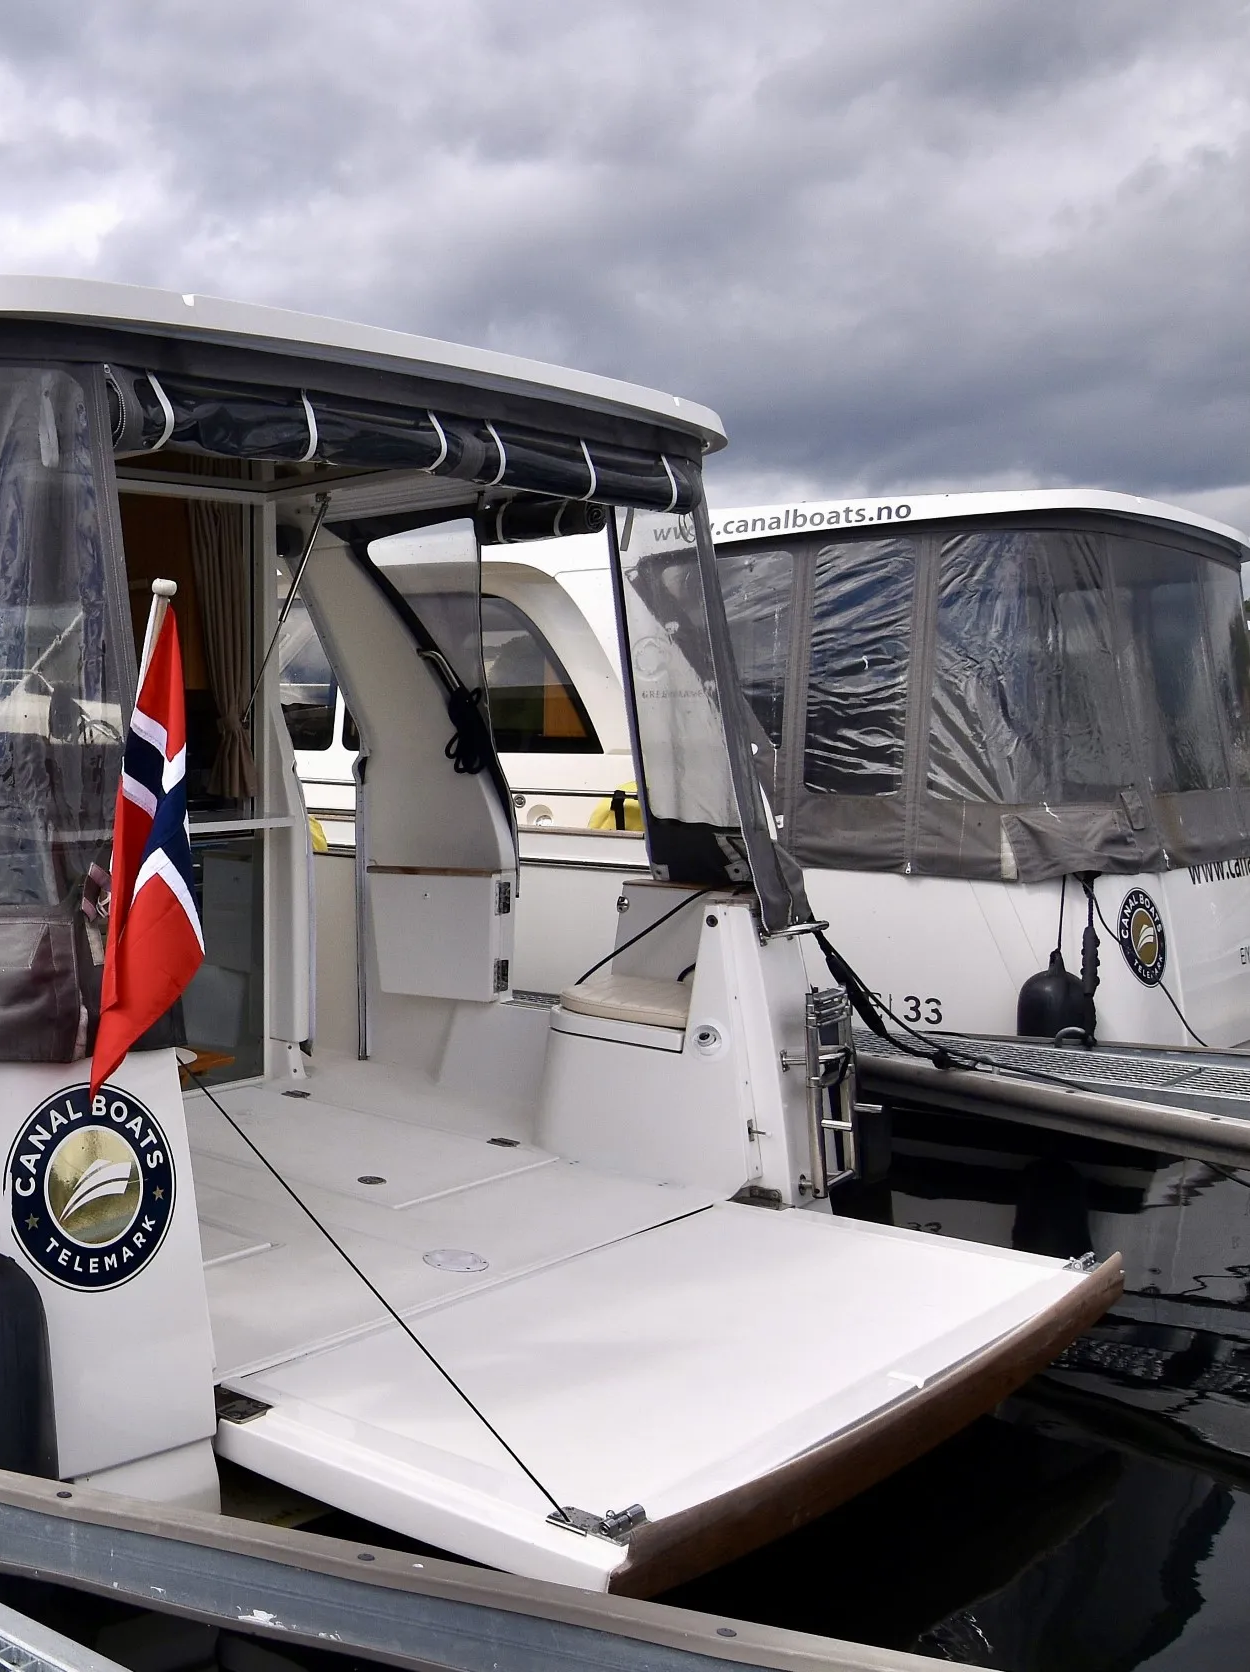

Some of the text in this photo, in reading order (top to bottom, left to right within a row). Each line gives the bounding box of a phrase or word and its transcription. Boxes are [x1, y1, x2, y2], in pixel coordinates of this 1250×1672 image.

[652, 503, 912, 541] ww.canalboats.no
[1121, 893, 1163, 939] CANAL BOATS
[1133, 954, 1163, 979] TELEARK
[903, 995, 943, 1025] 33
[15, 1094, 164, 1197] CANAL BOATS
[45, 1214, 157, 1274] TELEMARK
